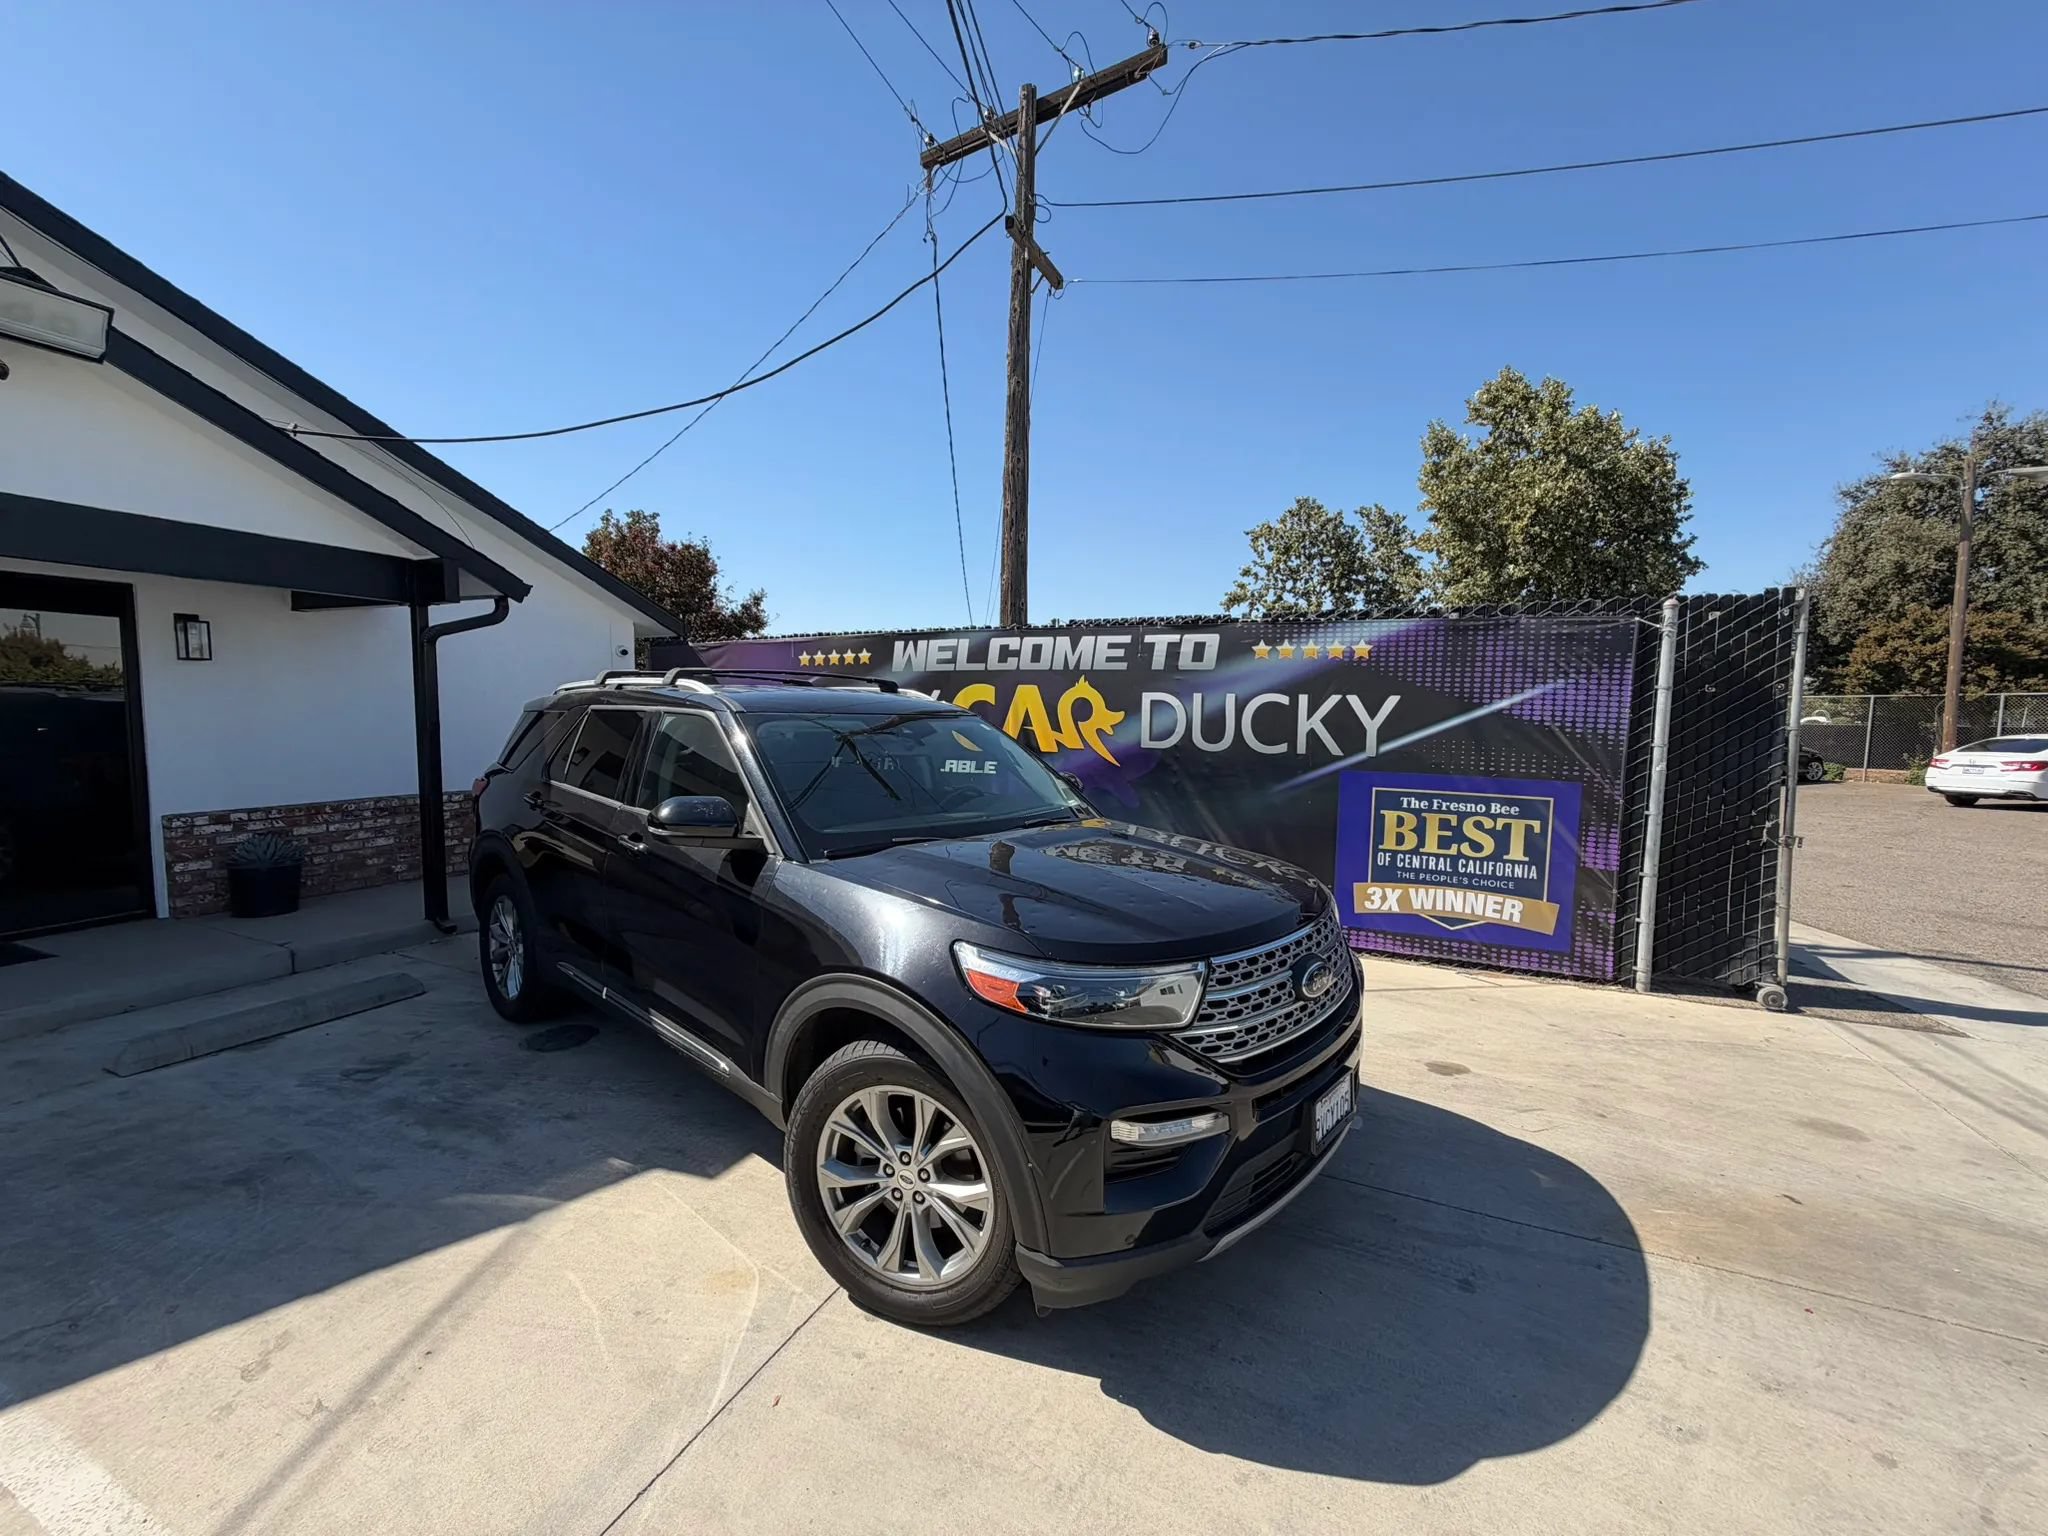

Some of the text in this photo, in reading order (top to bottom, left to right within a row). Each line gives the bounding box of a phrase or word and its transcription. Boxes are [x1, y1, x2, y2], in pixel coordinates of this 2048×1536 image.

[892, 633, 1221, 672] WELCOME TO
[1140, 691, 1401, 757] DUCKY
[940, 759, 998, 774] ABLE
[1400, 796, 1521, 816] The Fresno Bee
[1377, 809, 1541, 861] BEST
[1377, 852, 1538, 880] OF CENTRAL CALIFORNIA
[1396, 871, 1515, 889] THE PEOPLE'S CHOICE
[1363, 886, 1524, 923] 3X WINNER
